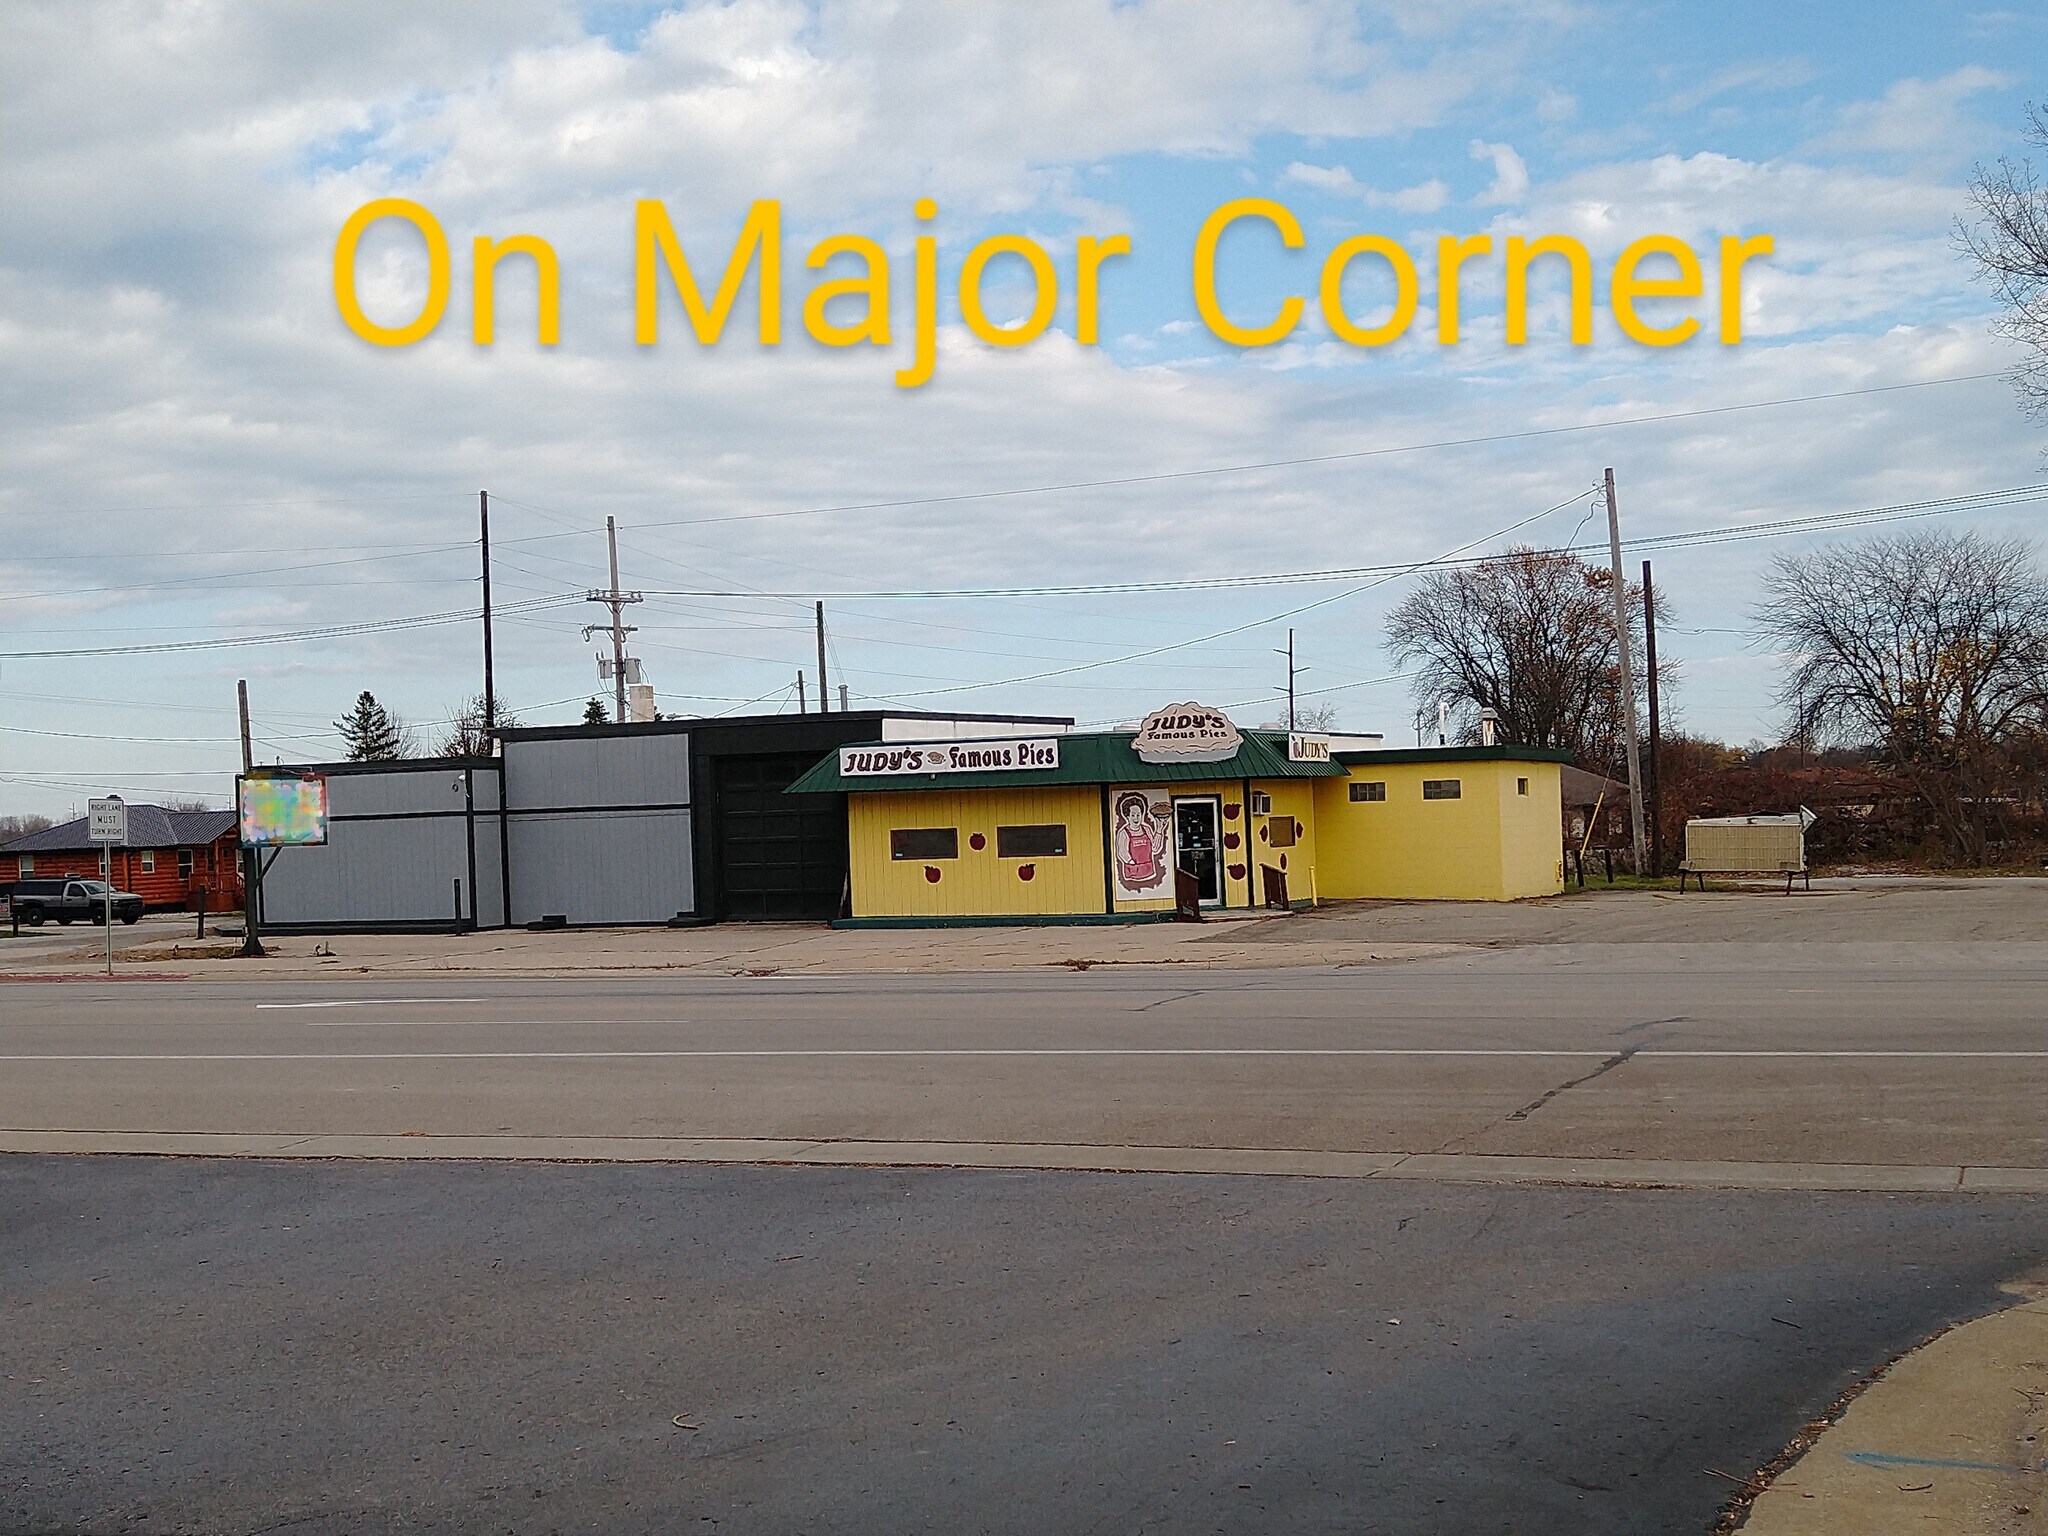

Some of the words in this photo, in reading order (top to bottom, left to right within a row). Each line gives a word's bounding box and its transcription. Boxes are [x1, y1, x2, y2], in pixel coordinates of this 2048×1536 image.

[1200, 729, 1228, 738] Pies
[1017, 743, 1055, 766] Pies
[97, 815, 116, 823] MUST
